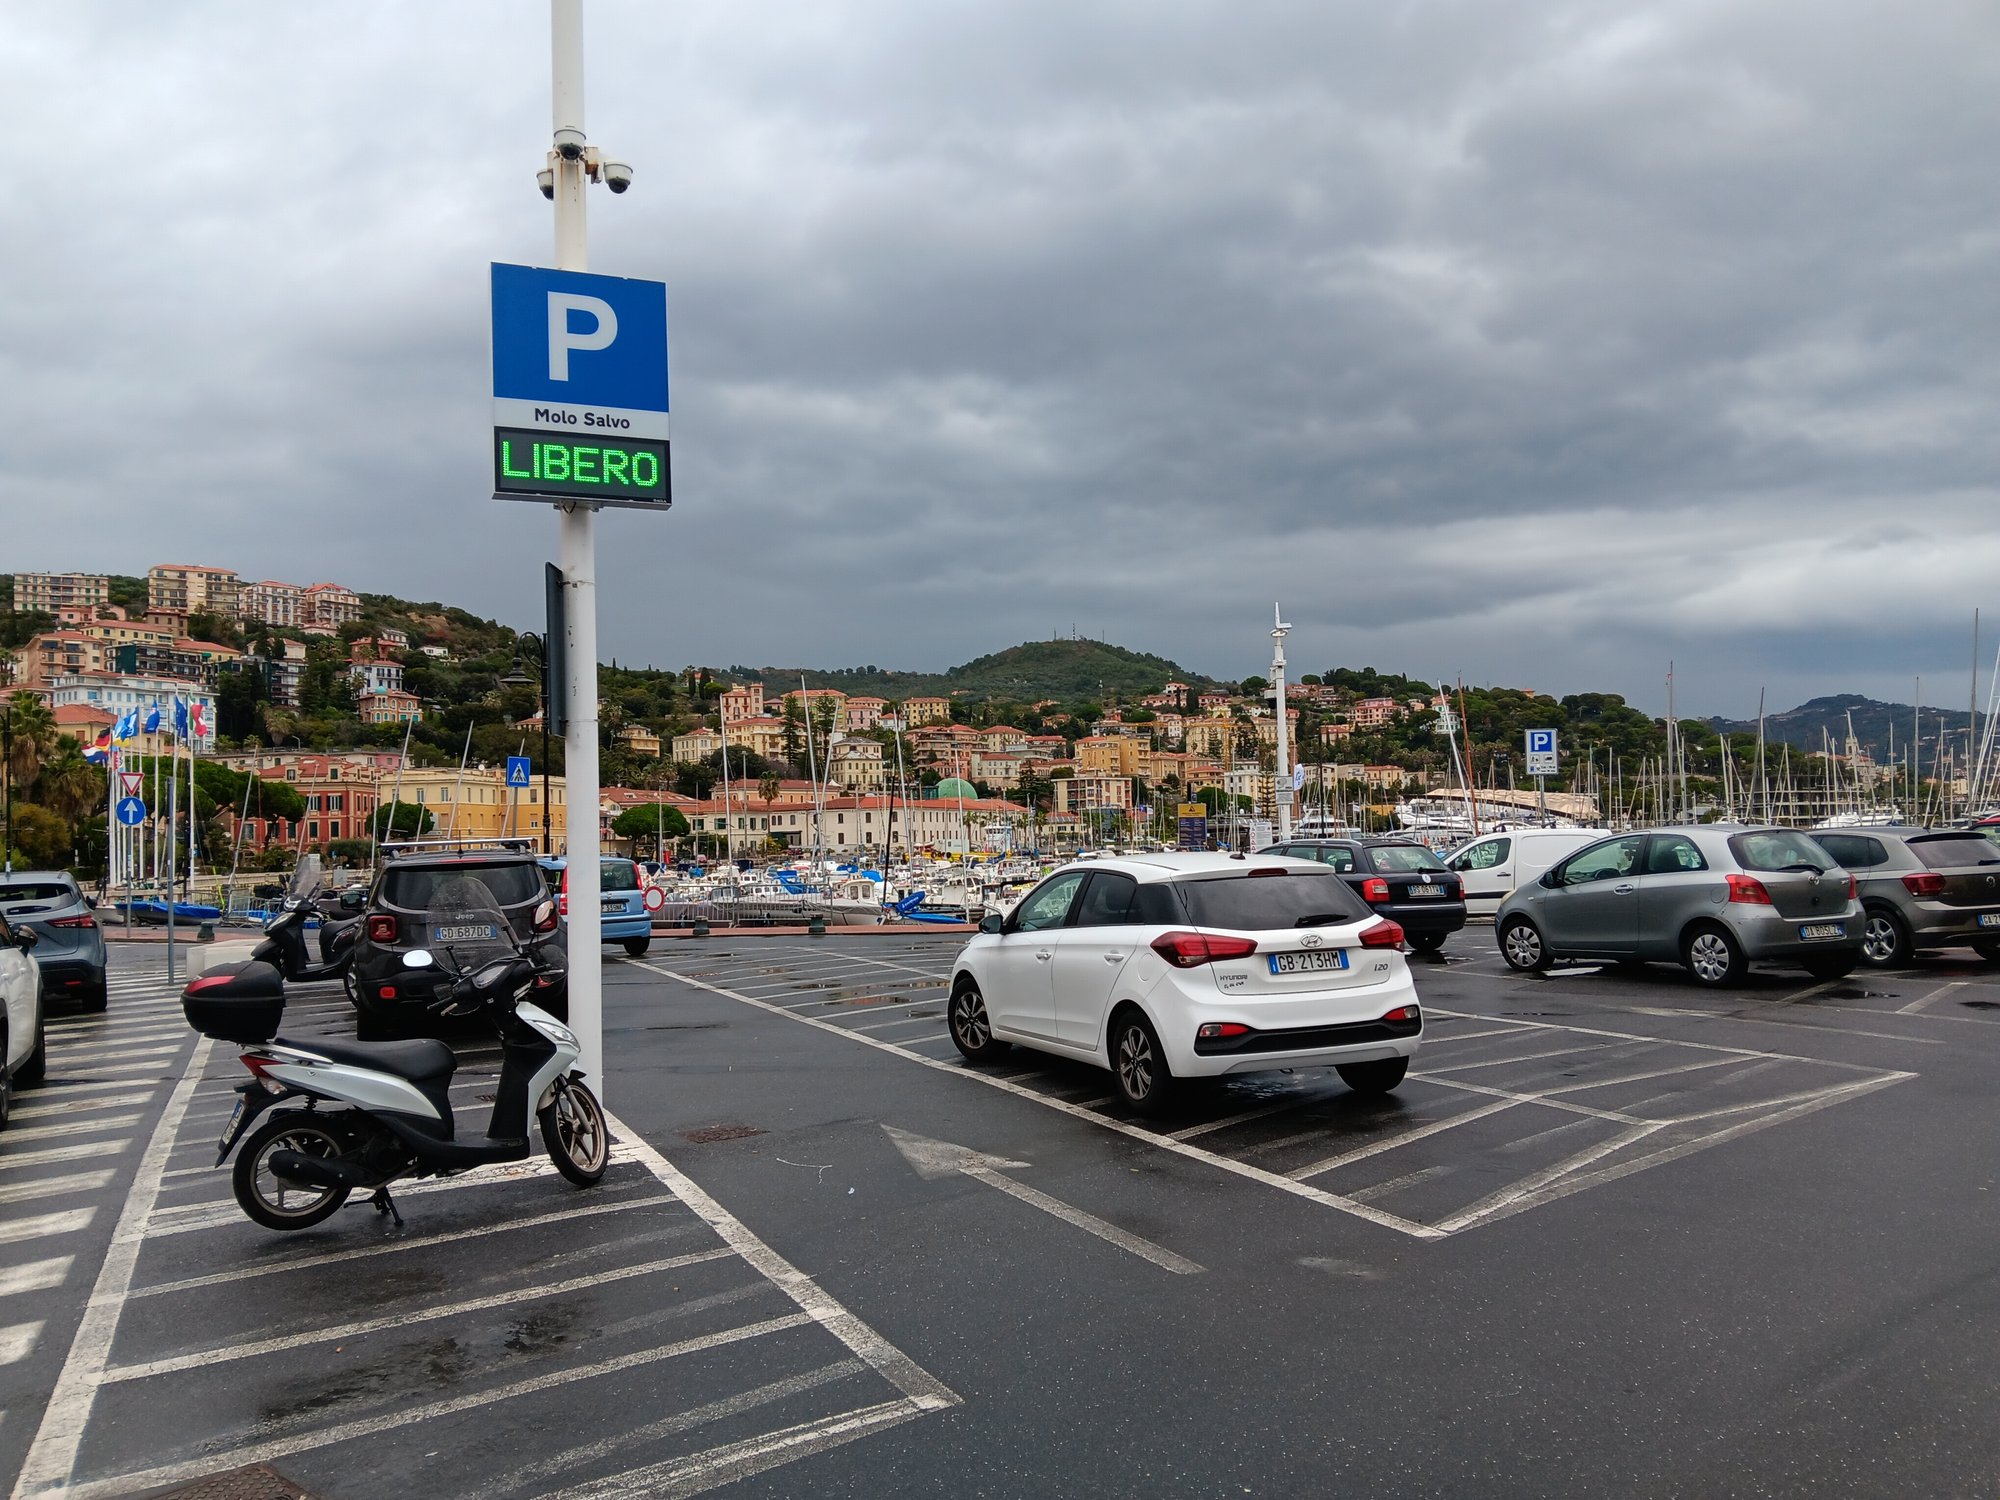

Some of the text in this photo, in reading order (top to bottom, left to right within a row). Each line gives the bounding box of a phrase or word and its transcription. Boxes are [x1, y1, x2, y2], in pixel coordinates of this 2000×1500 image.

[547, 290, 618, 382] P
[534, 408, 631, 429] Molo Salvo
[502, 441, 658, 486] LIBERO
[1534, 733, 1549, 751] P
[441, 928, 454, 938] GD
[1278, 950, 1341, 971] GB 213HM
